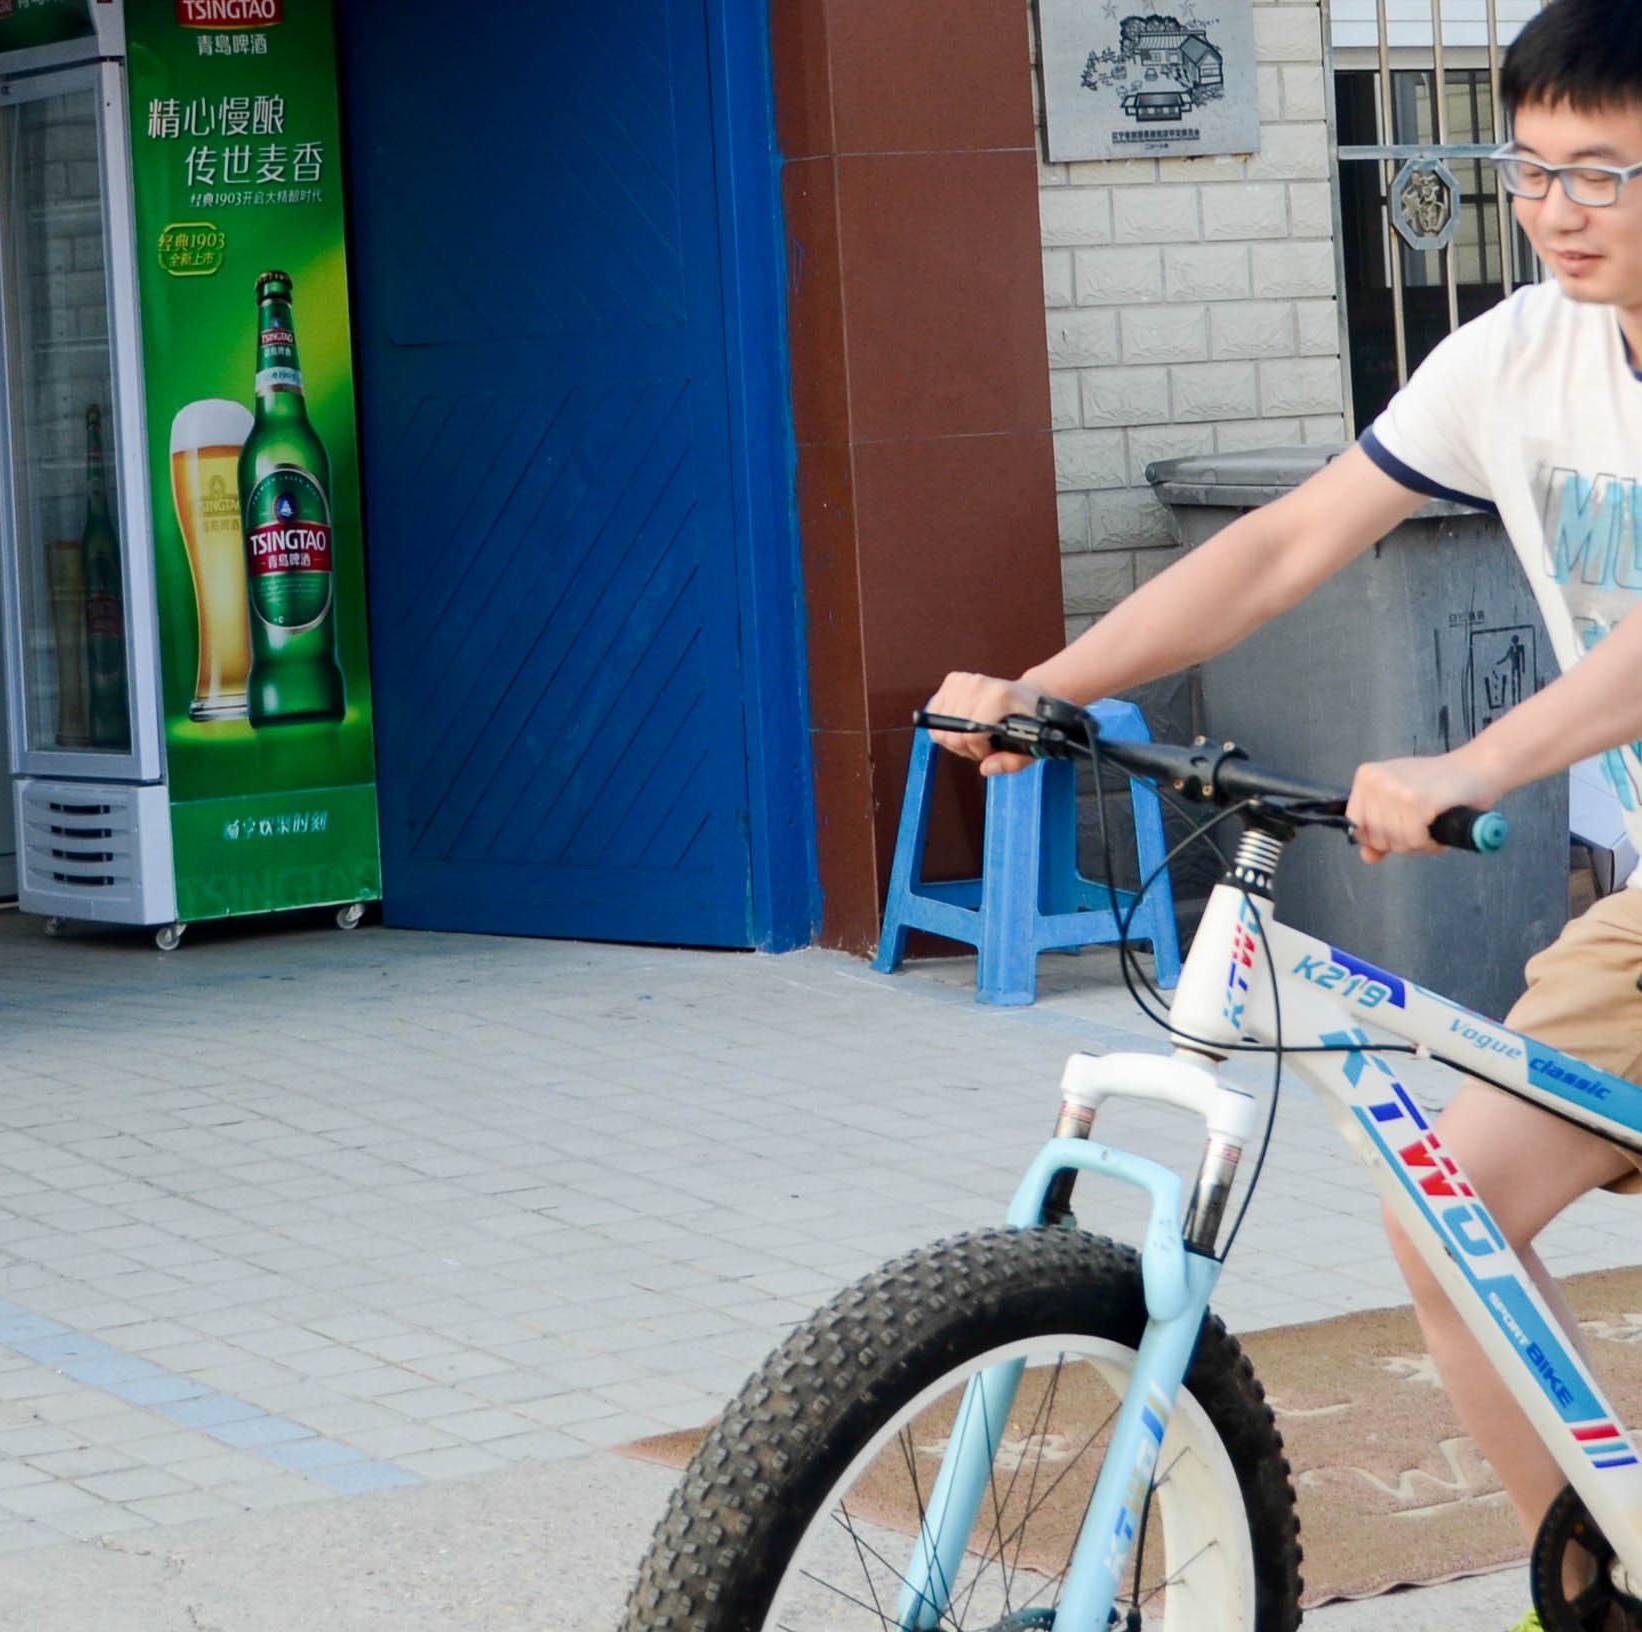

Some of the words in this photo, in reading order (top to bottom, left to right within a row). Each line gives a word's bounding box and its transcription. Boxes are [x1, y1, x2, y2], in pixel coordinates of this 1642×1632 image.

[148, 94, 284, 138] 精心慢酿
[185, 141, 324, 187] 传世麦香
[250, 529, 327, 556] TSINGTAO
[1291, 954, 1391, 1009] K219
[1450, 1018, 1522, 1060] Vogue
[1528, 1055, 1613, 1102] classic
[1487, 1290, 1527, 1346] SPORT
[1526, 1341, 1574, 1408] BIKE
